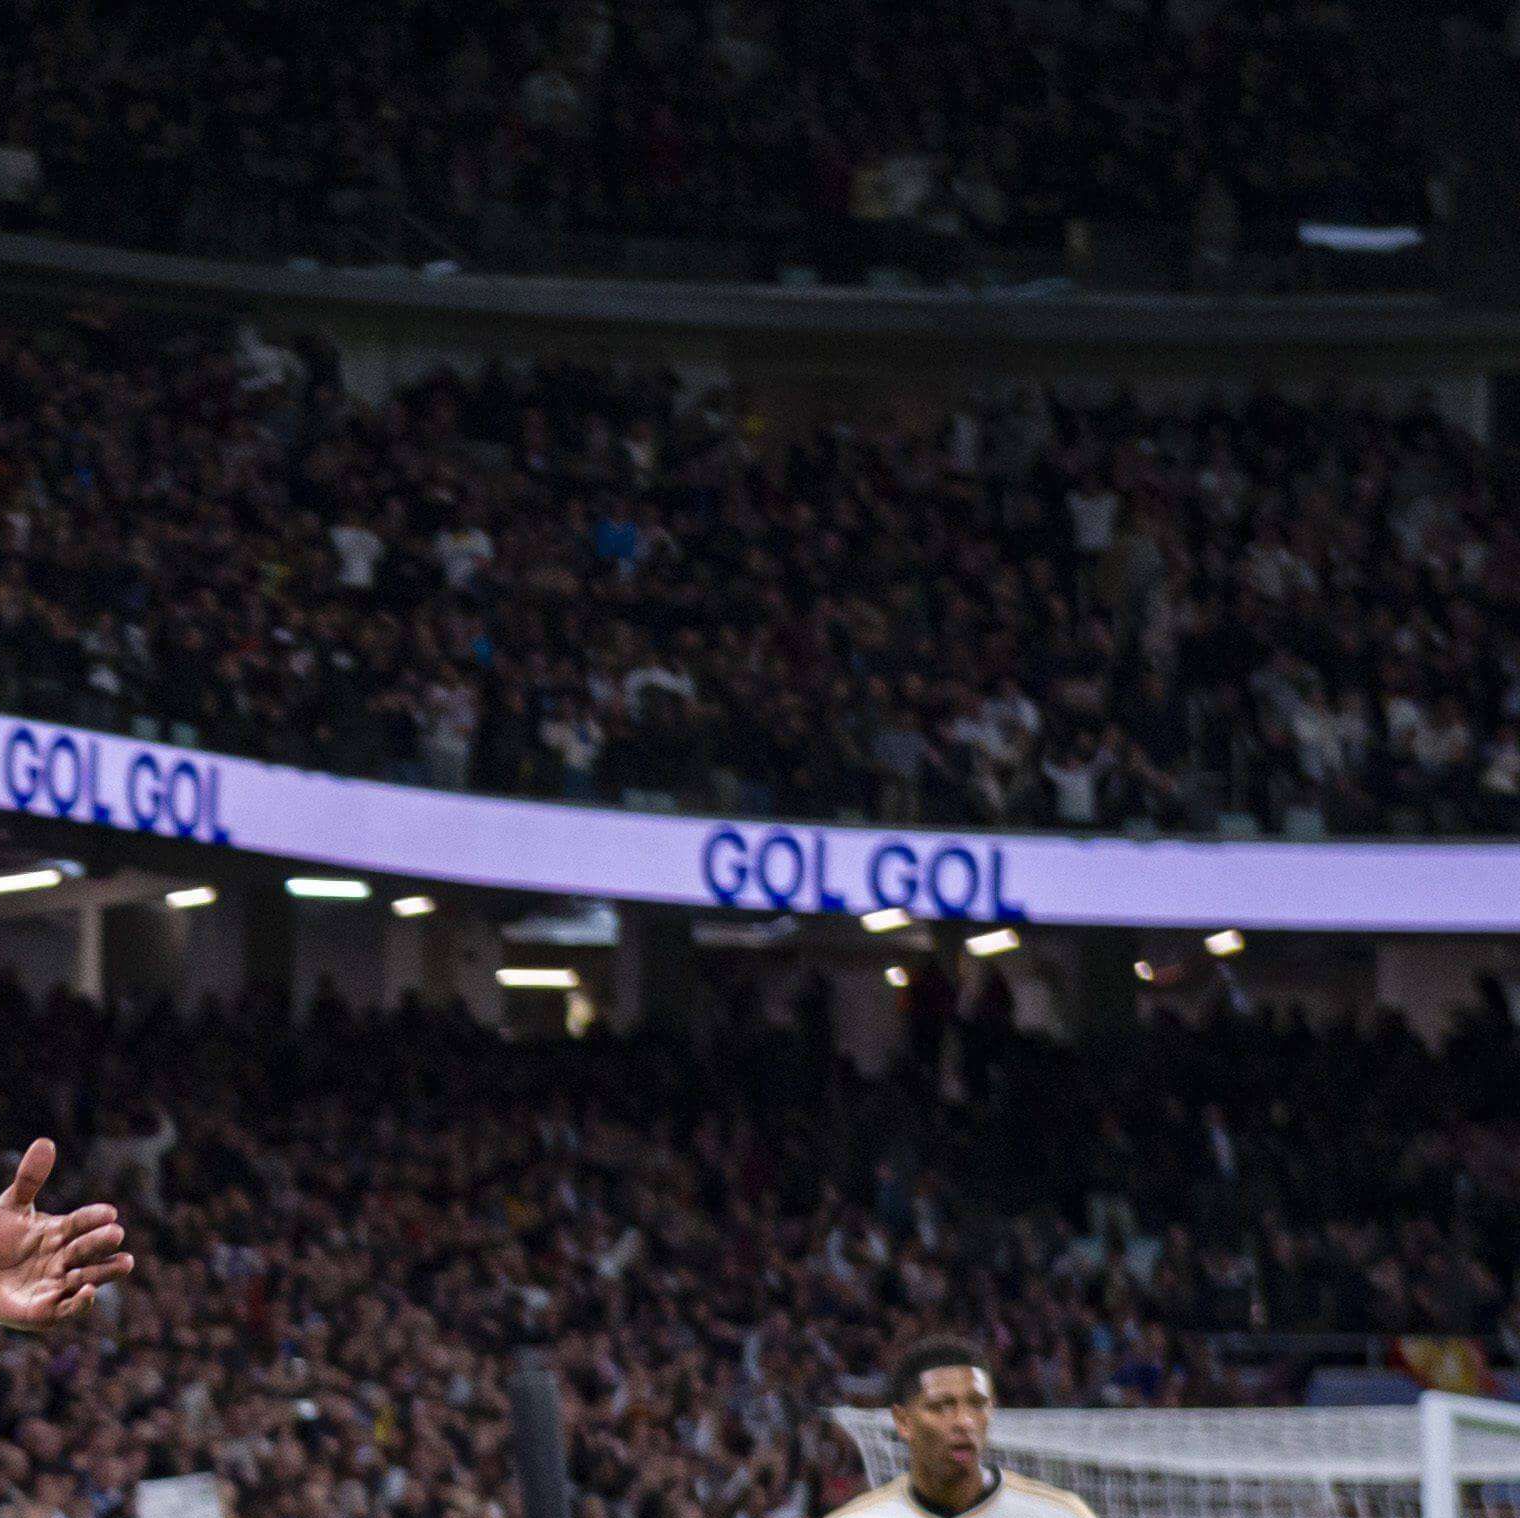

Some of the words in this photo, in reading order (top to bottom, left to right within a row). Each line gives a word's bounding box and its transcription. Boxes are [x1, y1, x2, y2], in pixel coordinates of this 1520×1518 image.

[4, 727, 111, 825] GOL
[127, 751, 232, 846] GOL
[704, 828, 847, 912] GOL
[869, 843, 1028, 922] GOL
